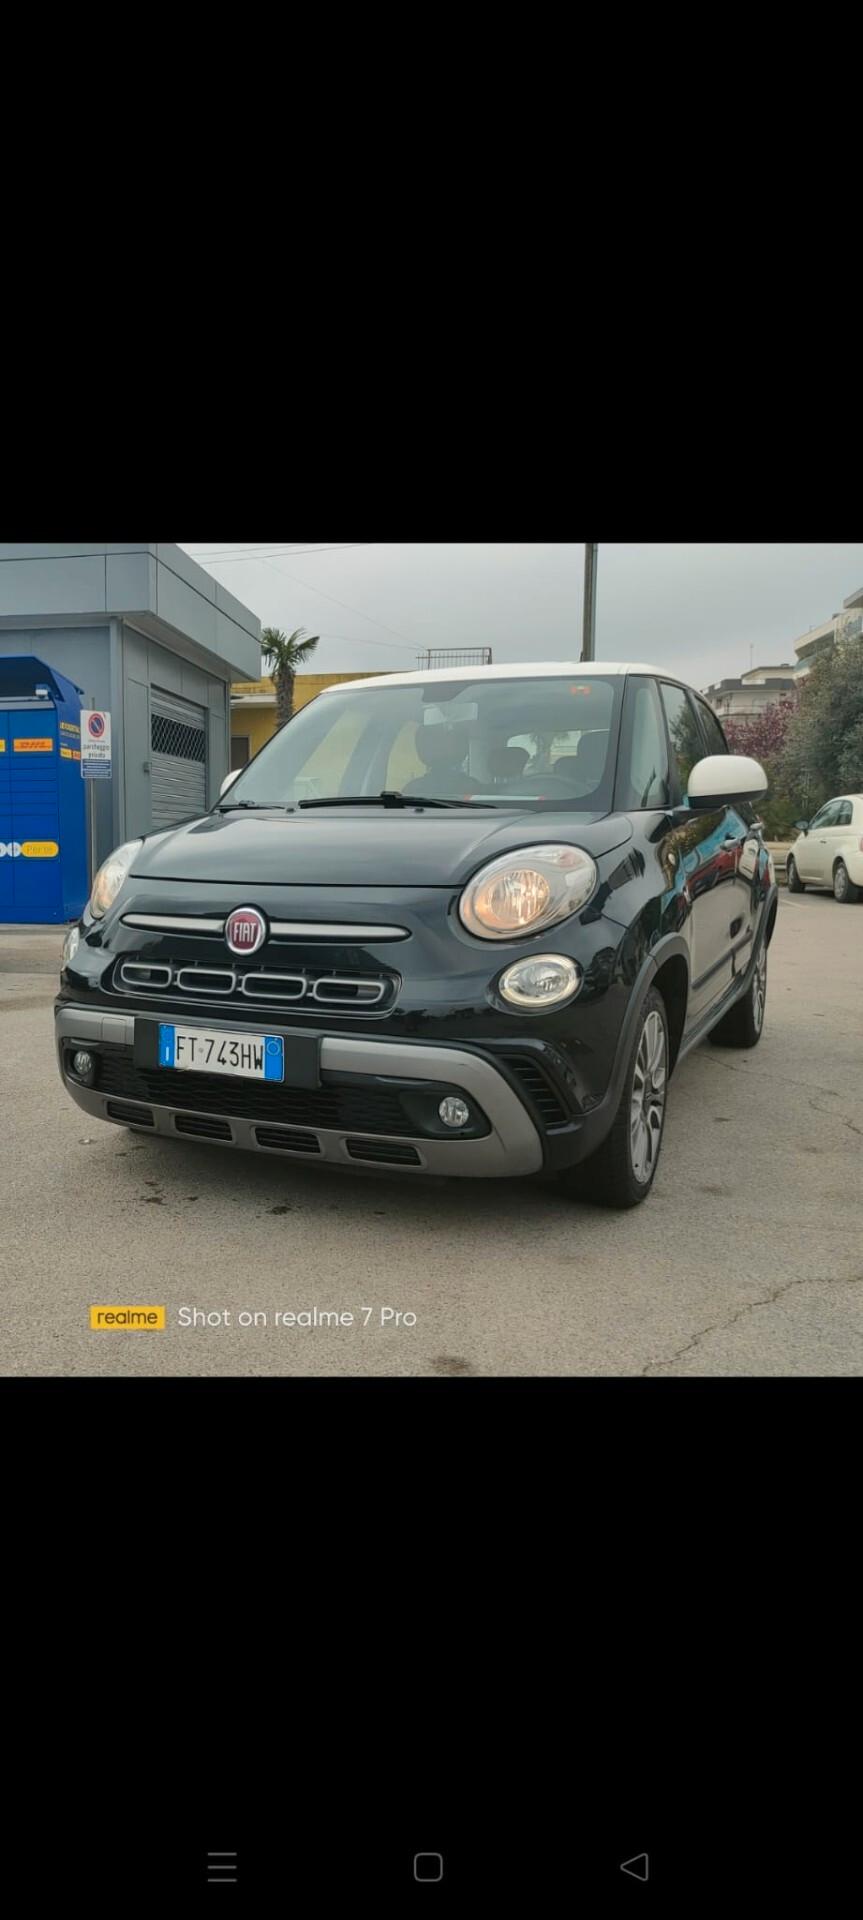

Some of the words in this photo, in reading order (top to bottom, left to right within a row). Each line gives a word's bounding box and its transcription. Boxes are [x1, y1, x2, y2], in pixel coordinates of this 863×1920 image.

[233, 922, 257, 943] FIAT
[176, 1035, 198, 1062] FT
[204, 1039, 264, 1071] 743HW
